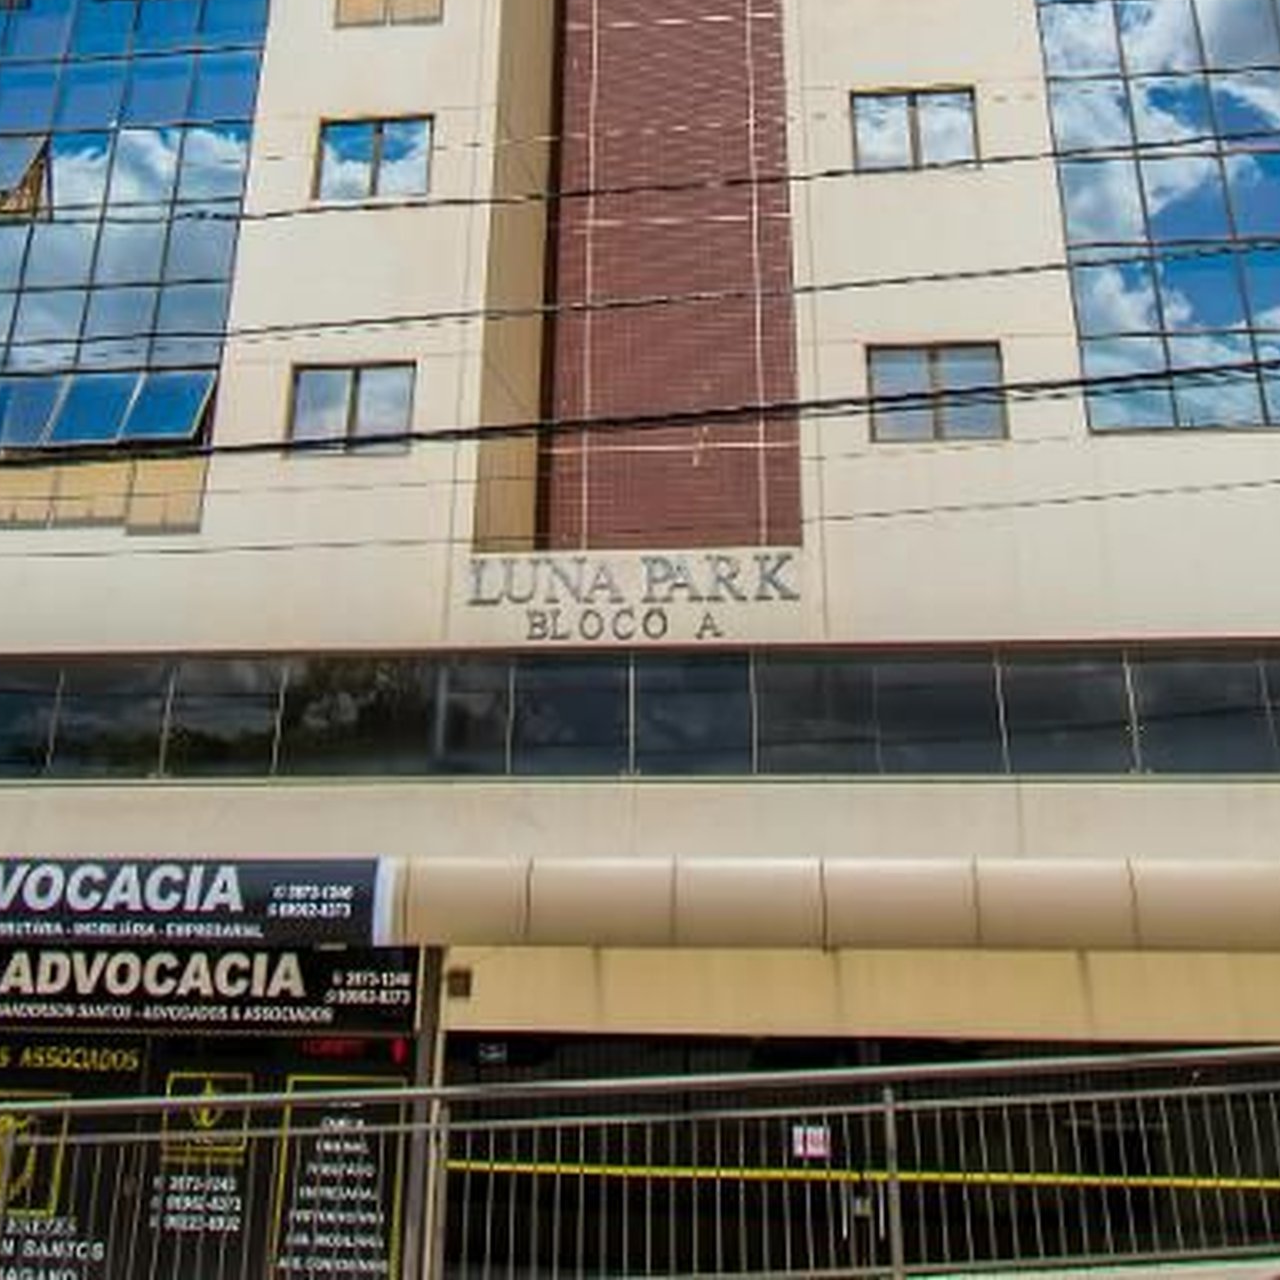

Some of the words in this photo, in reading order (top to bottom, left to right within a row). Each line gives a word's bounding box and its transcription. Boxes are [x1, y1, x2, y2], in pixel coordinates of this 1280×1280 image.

[468, 556, 624, 605] LUNA
[639, 553, 800, 603] PARK
[525, 608, 669, 640] BLOCO
[695, 612, 724, 639] A
[19, 1044, 139, 1071] ASSOCIADOS
[23, 1237, 105, 1260] SANTOS
